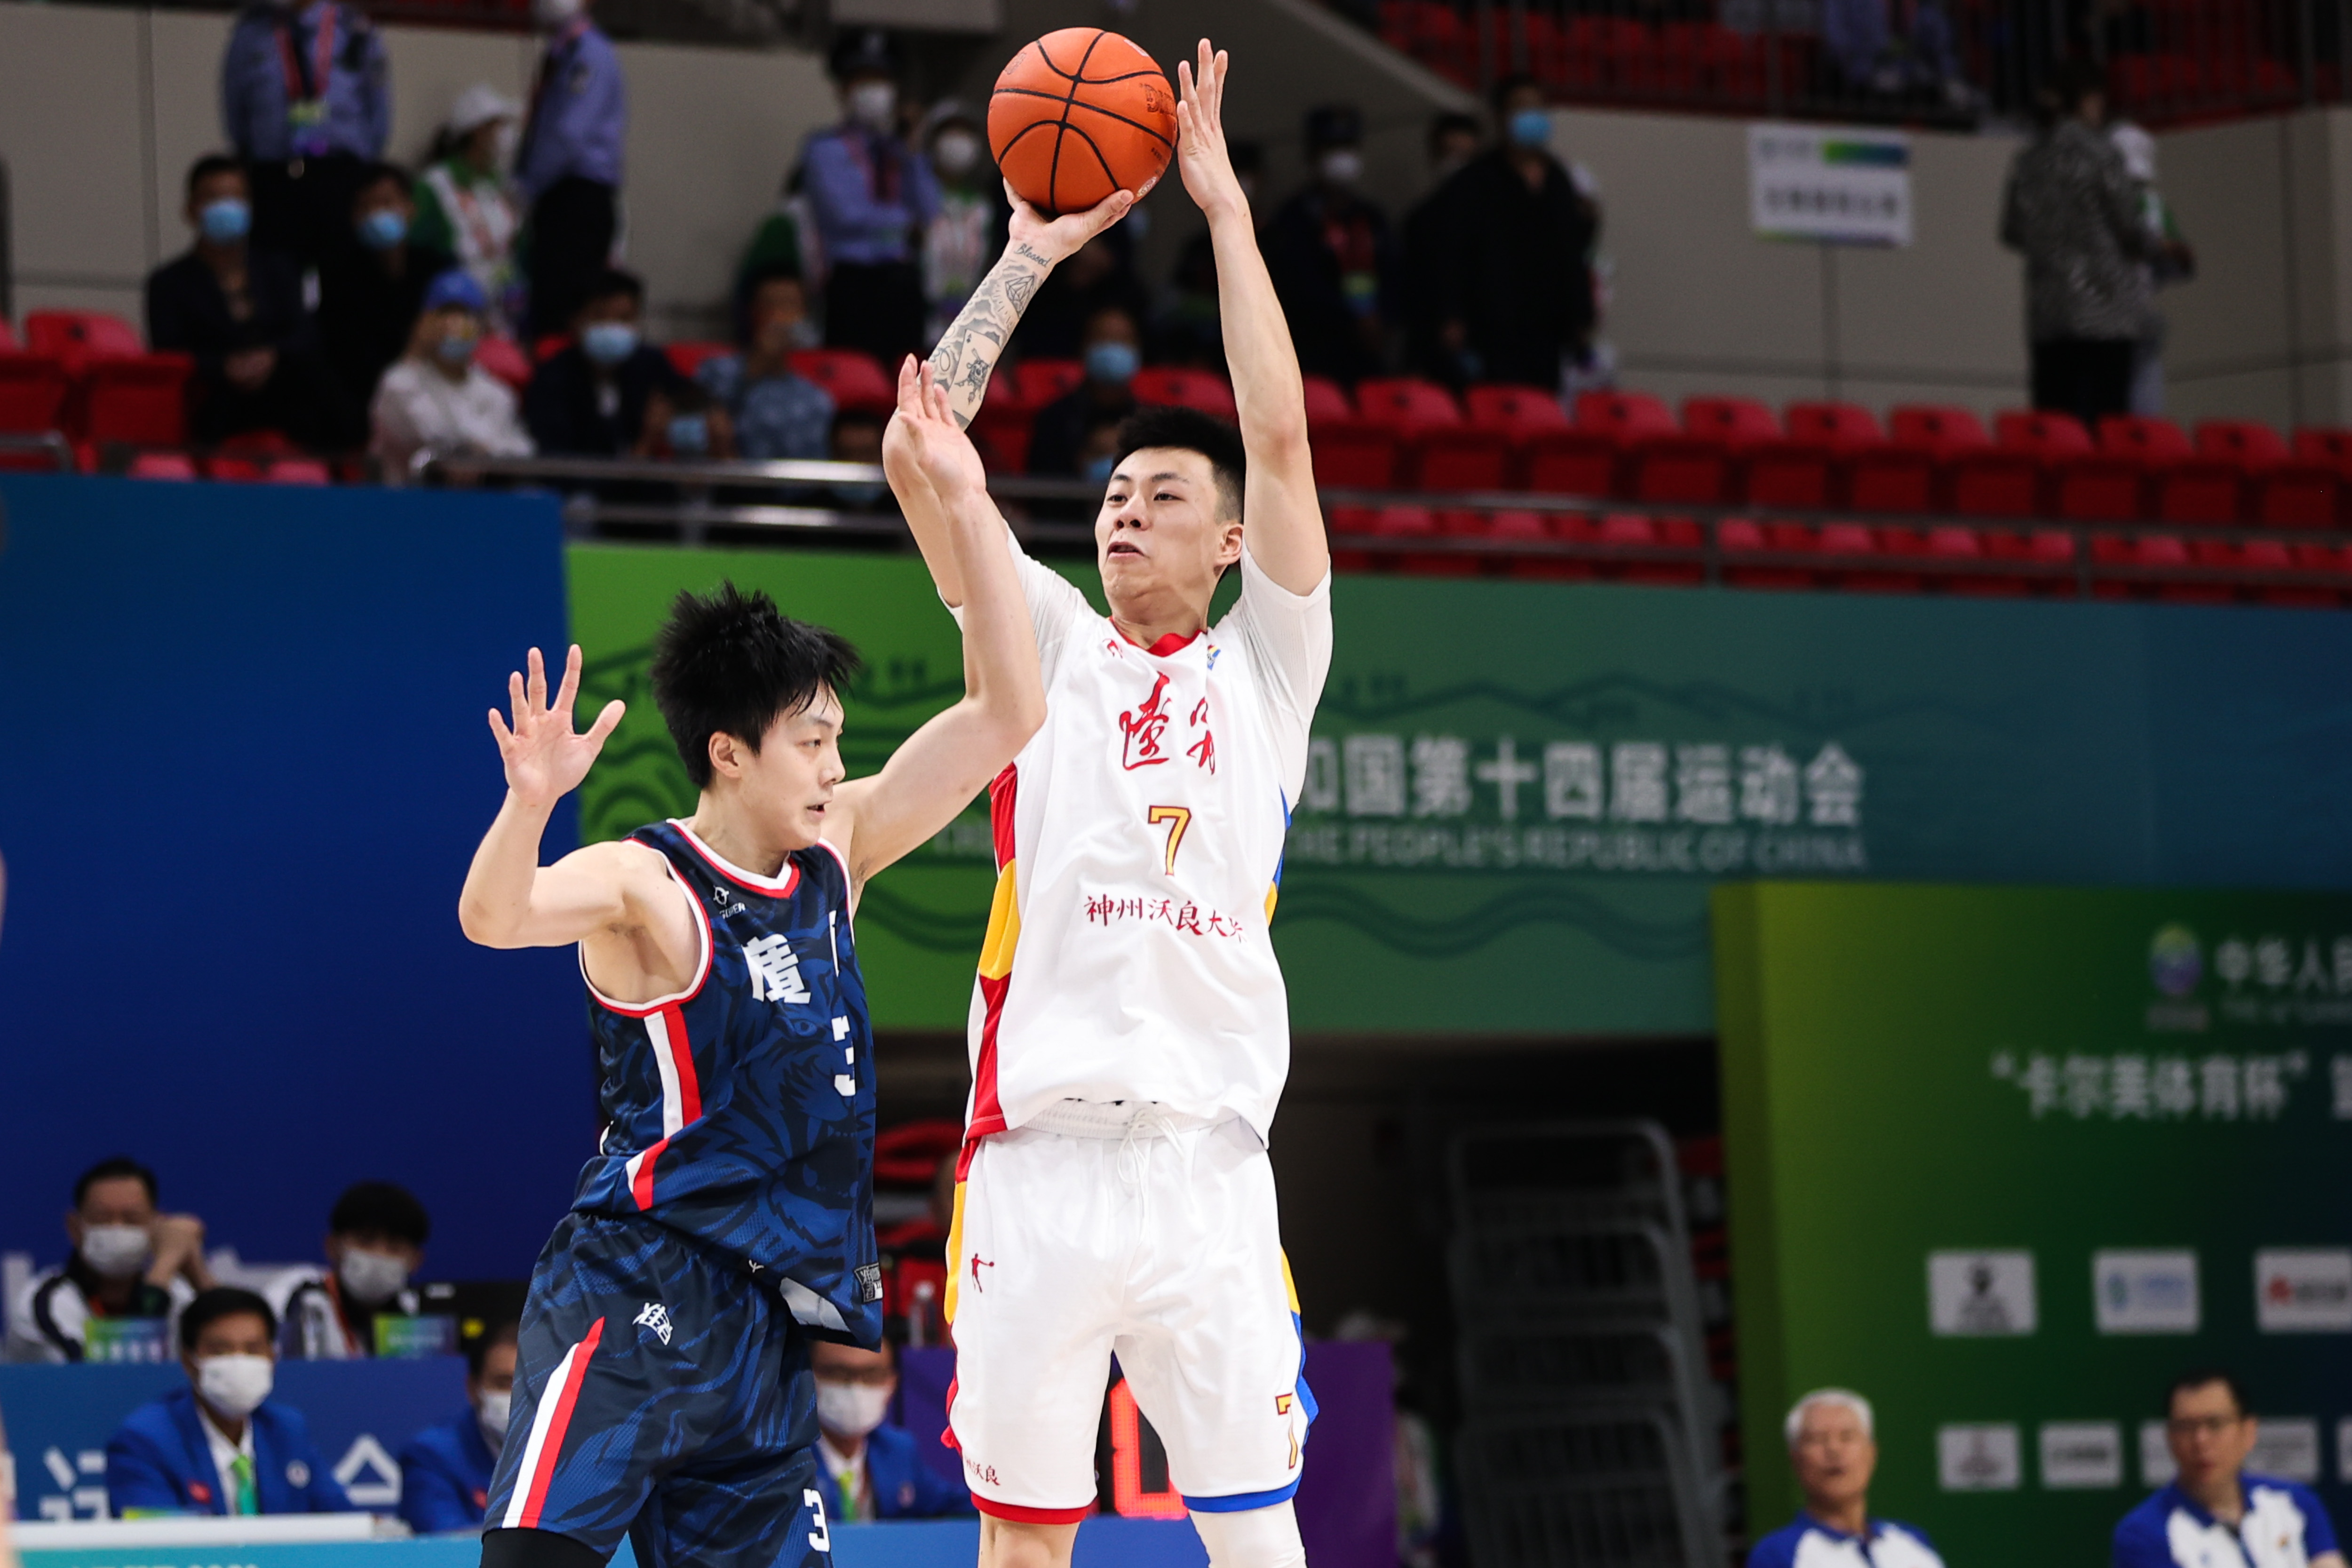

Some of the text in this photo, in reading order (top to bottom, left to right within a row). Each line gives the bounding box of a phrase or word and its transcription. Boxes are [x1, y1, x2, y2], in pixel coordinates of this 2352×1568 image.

[1014, 243, 1052, 268] Blessed
[1147, 805, 1192, 876] 7
[1523, 827, 1696, 872] REPUBLIC
[1699, 828, 1747, 872] OF
[1753, 829, 1867, 873] CHINA
[1275, 1393, 1298, 1470] 7
[803, 1488, 831, 1553] 3
